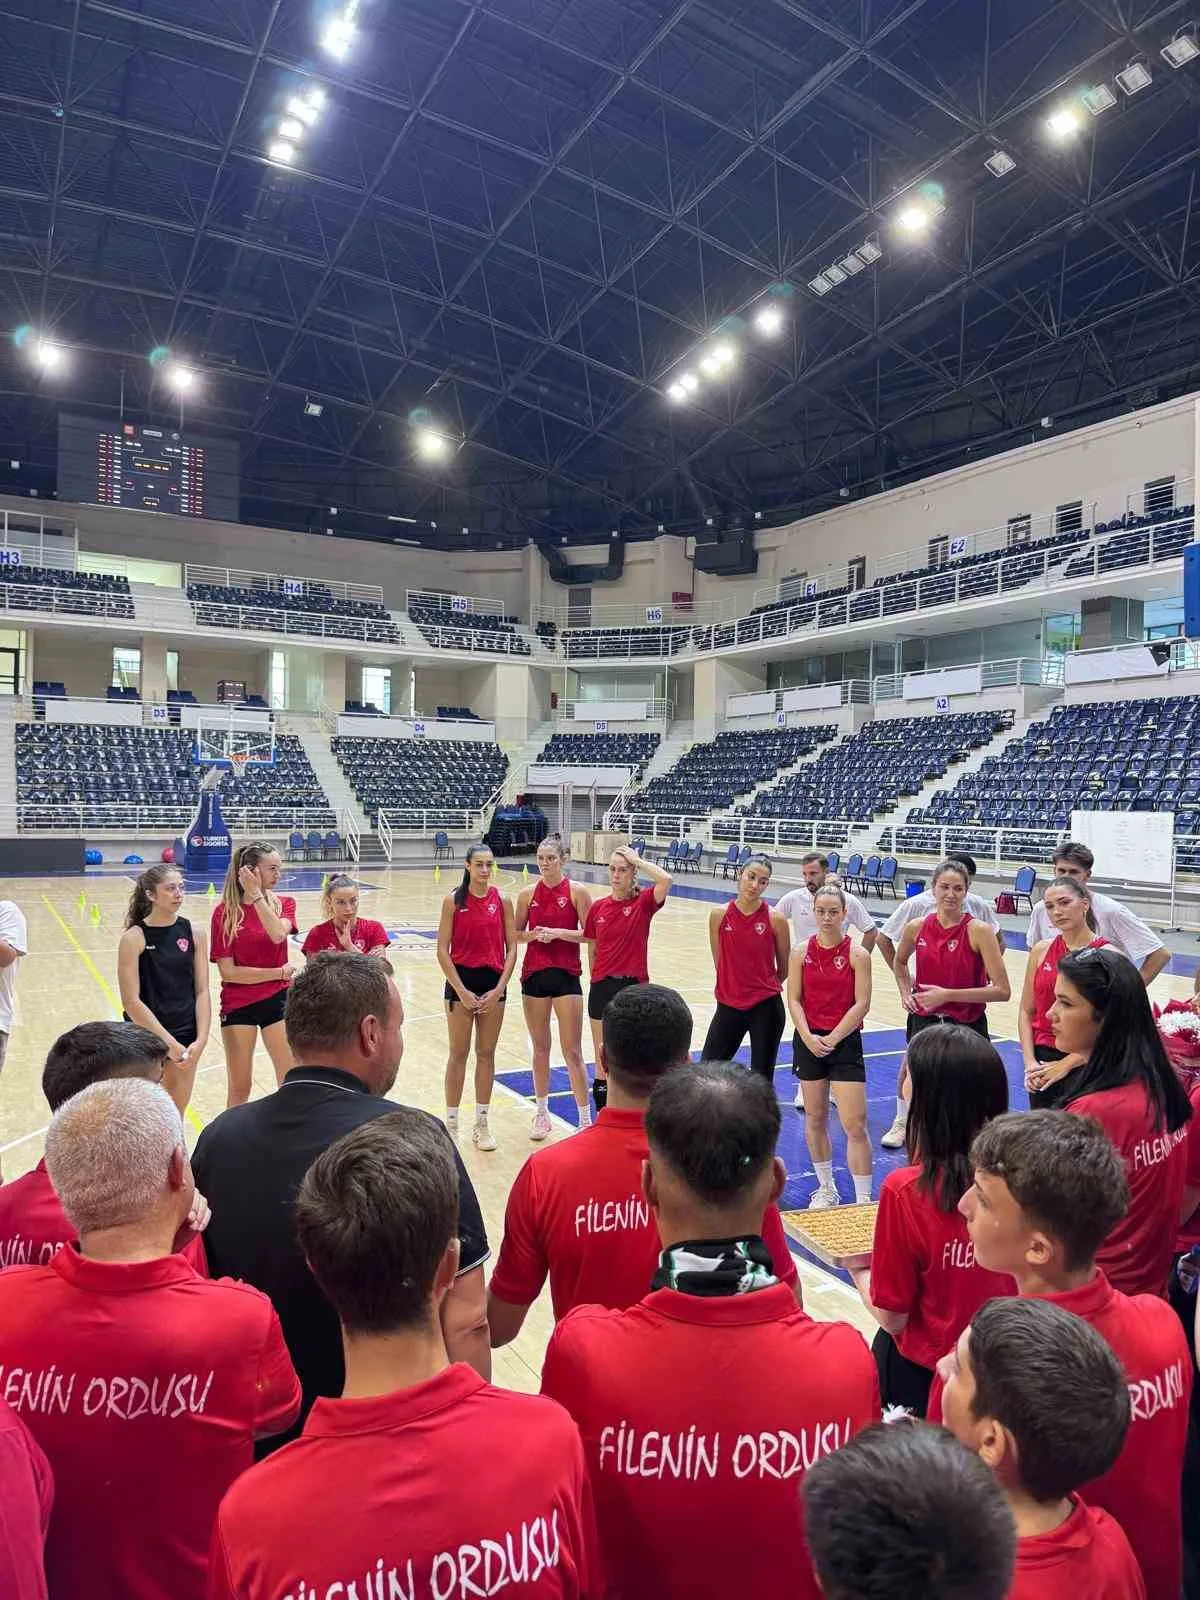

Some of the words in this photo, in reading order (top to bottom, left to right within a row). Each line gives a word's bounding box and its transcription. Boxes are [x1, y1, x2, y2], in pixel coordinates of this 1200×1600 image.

[951, 539, 965, 555] E2
[0, 551, 20, 565] H3
[285, 582, 302, 593] H4
[806, 583, 817, 595] E1
[452, 598, 467, 609] H5
[647, 609, 662, 620] H6
[936, 698, 947, 709] A2
[153, 708, 165, 718] D3
[415, 723, 425, 731] D4
[596, 722, 606, 730] D5
[574, 1193, 650, 1238] FİLENİN
[942, 1238, 976, 1270] FİLE
[0, 1364, 76, 1415] ENİN
[83, 1369, 215, 1420] ORDUSU
[600, 1420, 720, 1480] FİLENİN
[430, 1508, 560, 1600] ORDUSU
